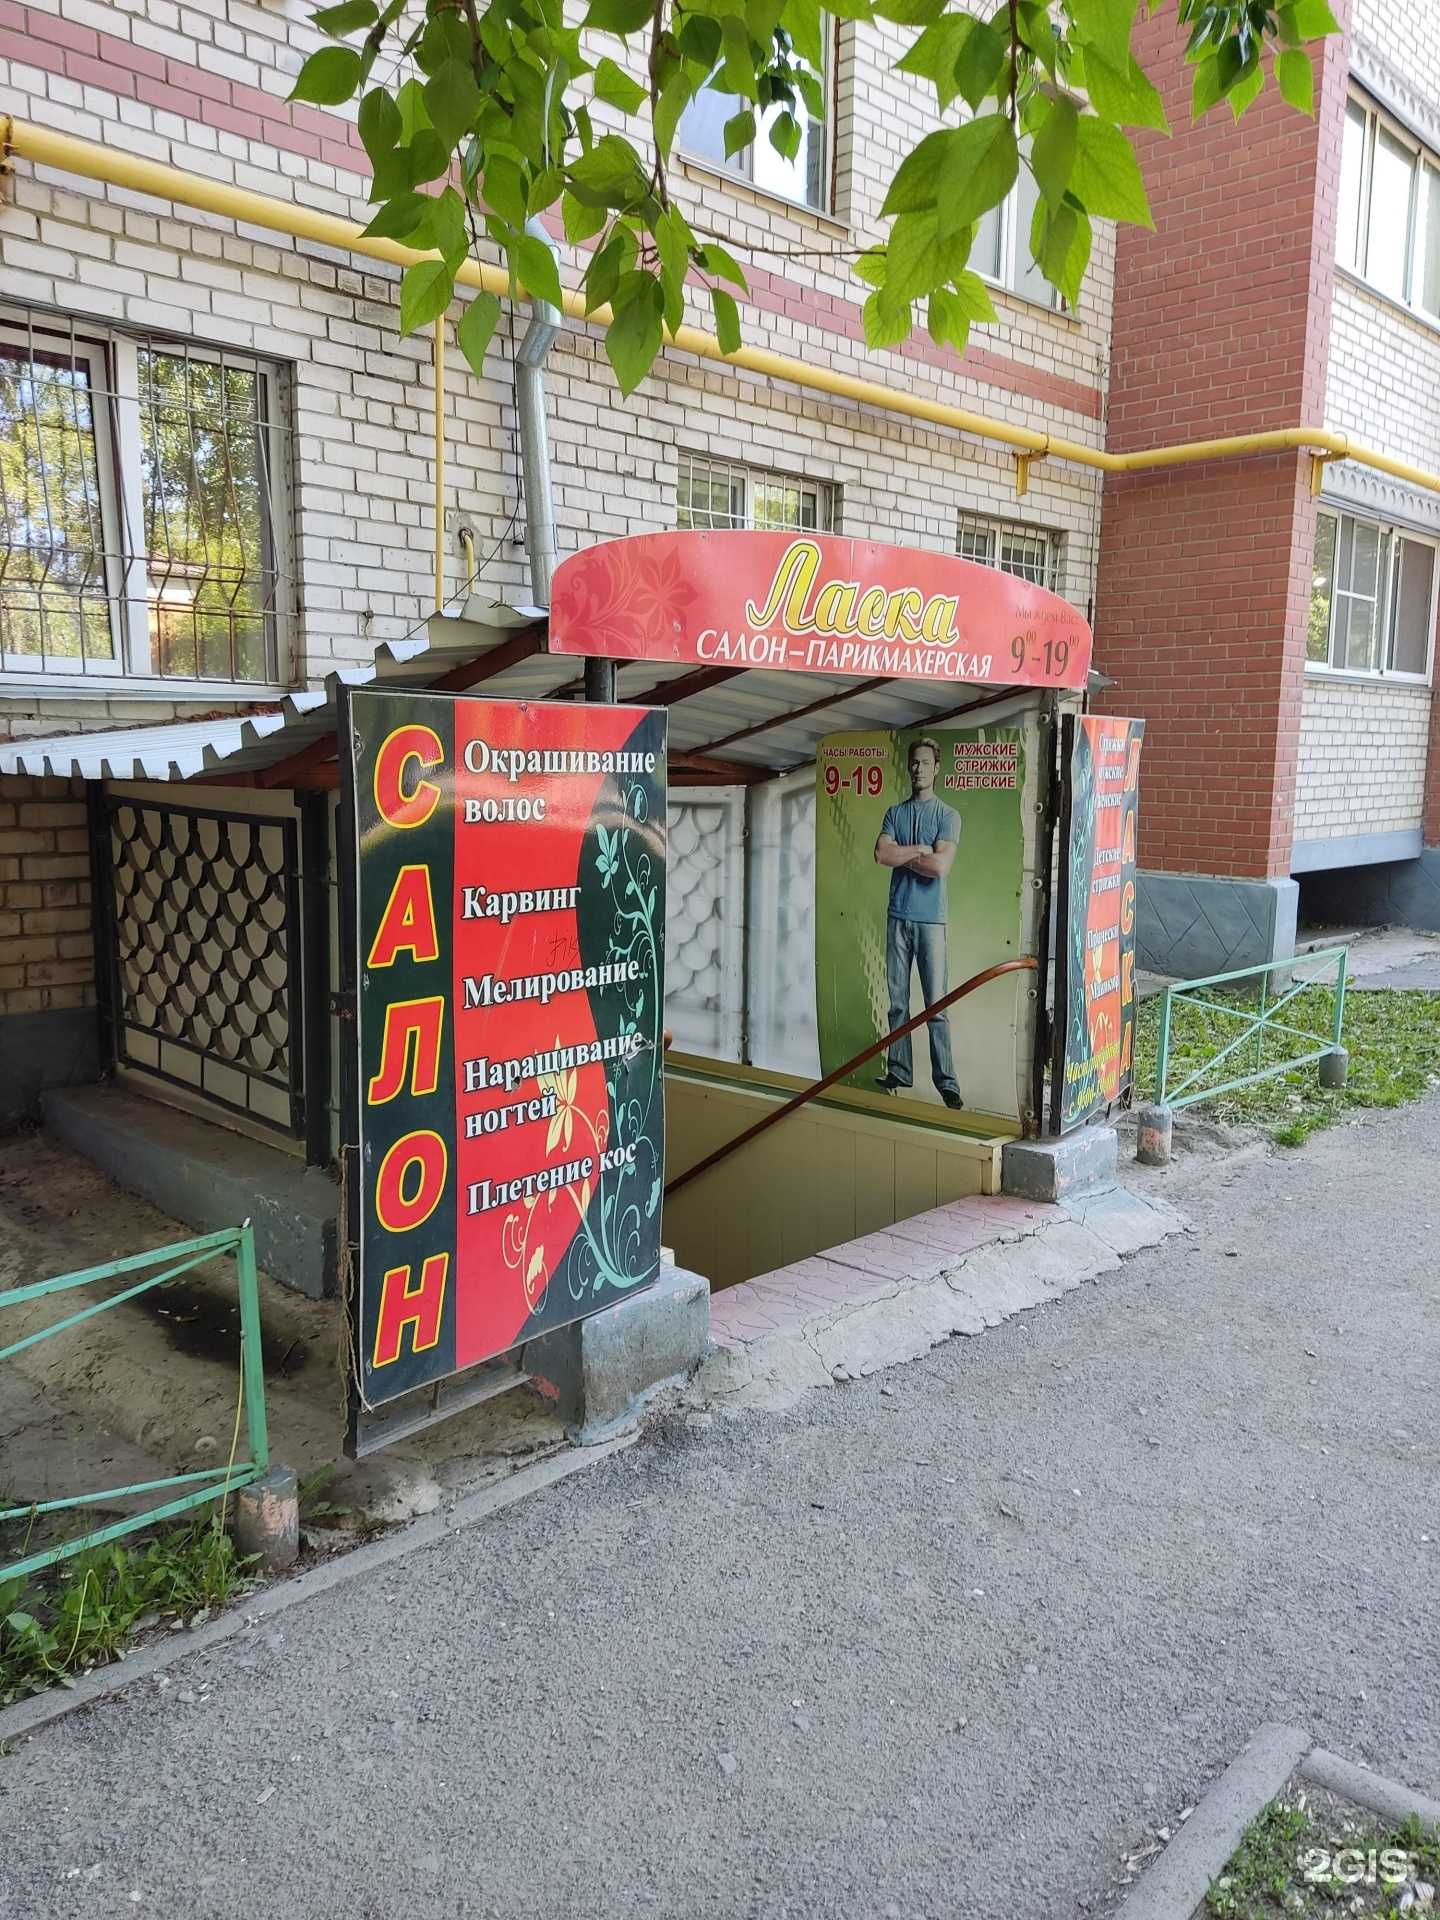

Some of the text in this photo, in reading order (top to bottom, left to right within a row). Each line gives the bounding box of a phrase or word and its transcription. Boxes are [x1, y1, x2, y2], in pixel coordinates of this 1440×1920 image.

[747, 539, 960, 647] Ласка
[696, 629, 992, 679] САЛОН-ПАРИКМАХЕРСКАЯ
[464, 739, 656, 781] Окрашивание
[823, 747, 847, 757] ЧАСЫ
[954, 743, 1018, 756] МУЖСКИЕ
[955, 760, 1017, 773] СТРИЖКИ
[825, 765, 884, 795] 9-19
[945, 775, 1016, 790] И ДЕТСКИЕ
[464, 796, 546, 824] волос
[462, 885, 582, 923] Карвинг
[1120, 738, 1142, 1077] ЛАСКА
[463, 957, 640, 1010] Мелирование
[367, 724, 449, 1369] САЛОН
[463, 1029, 643, 1093] Наращивание
[464, 1087, 558, 1139] ногтей
[466, 1142, 637, 1216] Плетение кос
